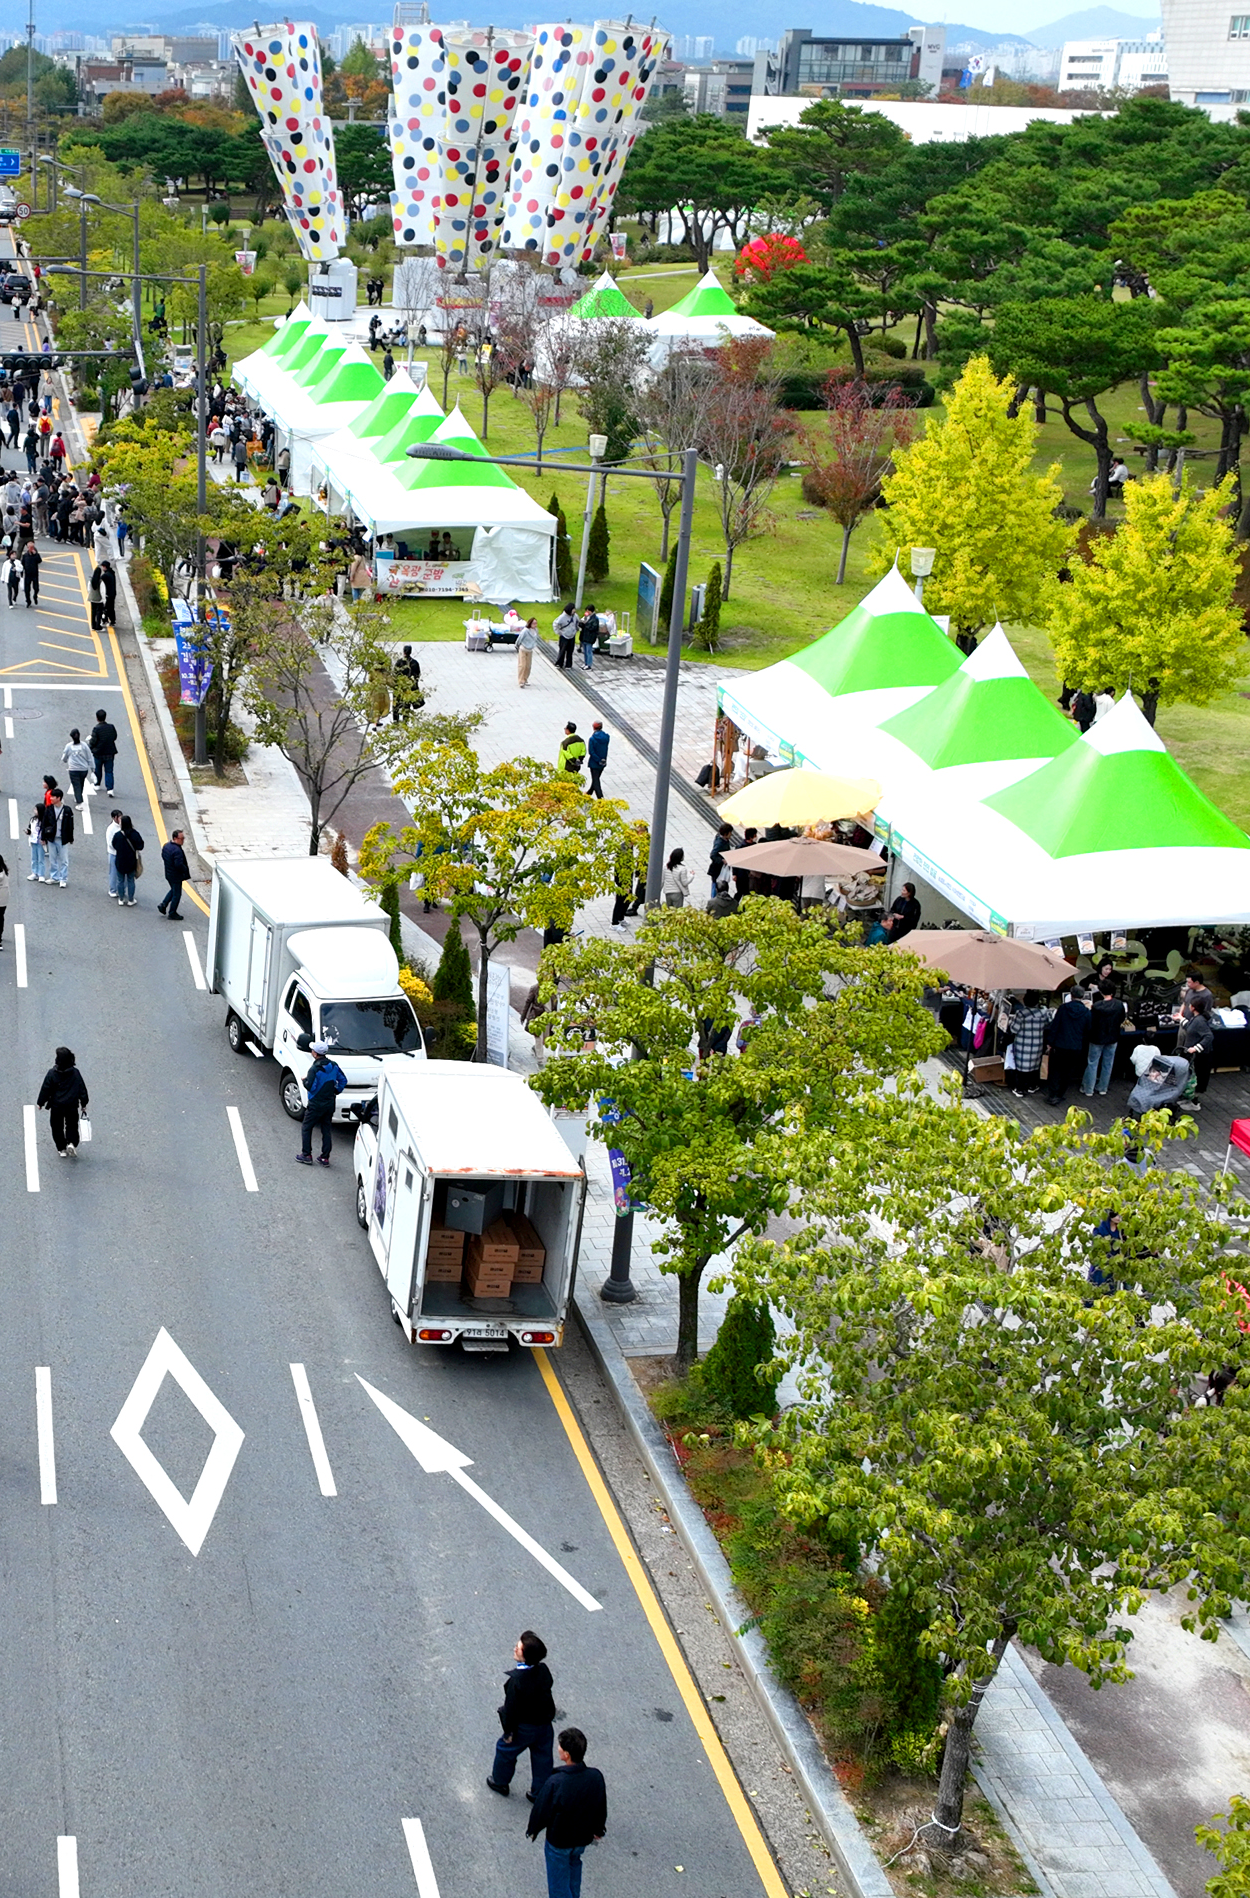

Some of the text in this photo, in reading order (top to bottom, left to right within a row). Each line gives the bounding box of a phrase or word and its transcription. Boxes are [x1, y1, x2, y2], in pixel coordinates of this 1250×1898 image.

[18, 206, 29, 216] 50
[423, 568, 444, 581] 군밤
[484, 1328, 505, 1337] 5014
